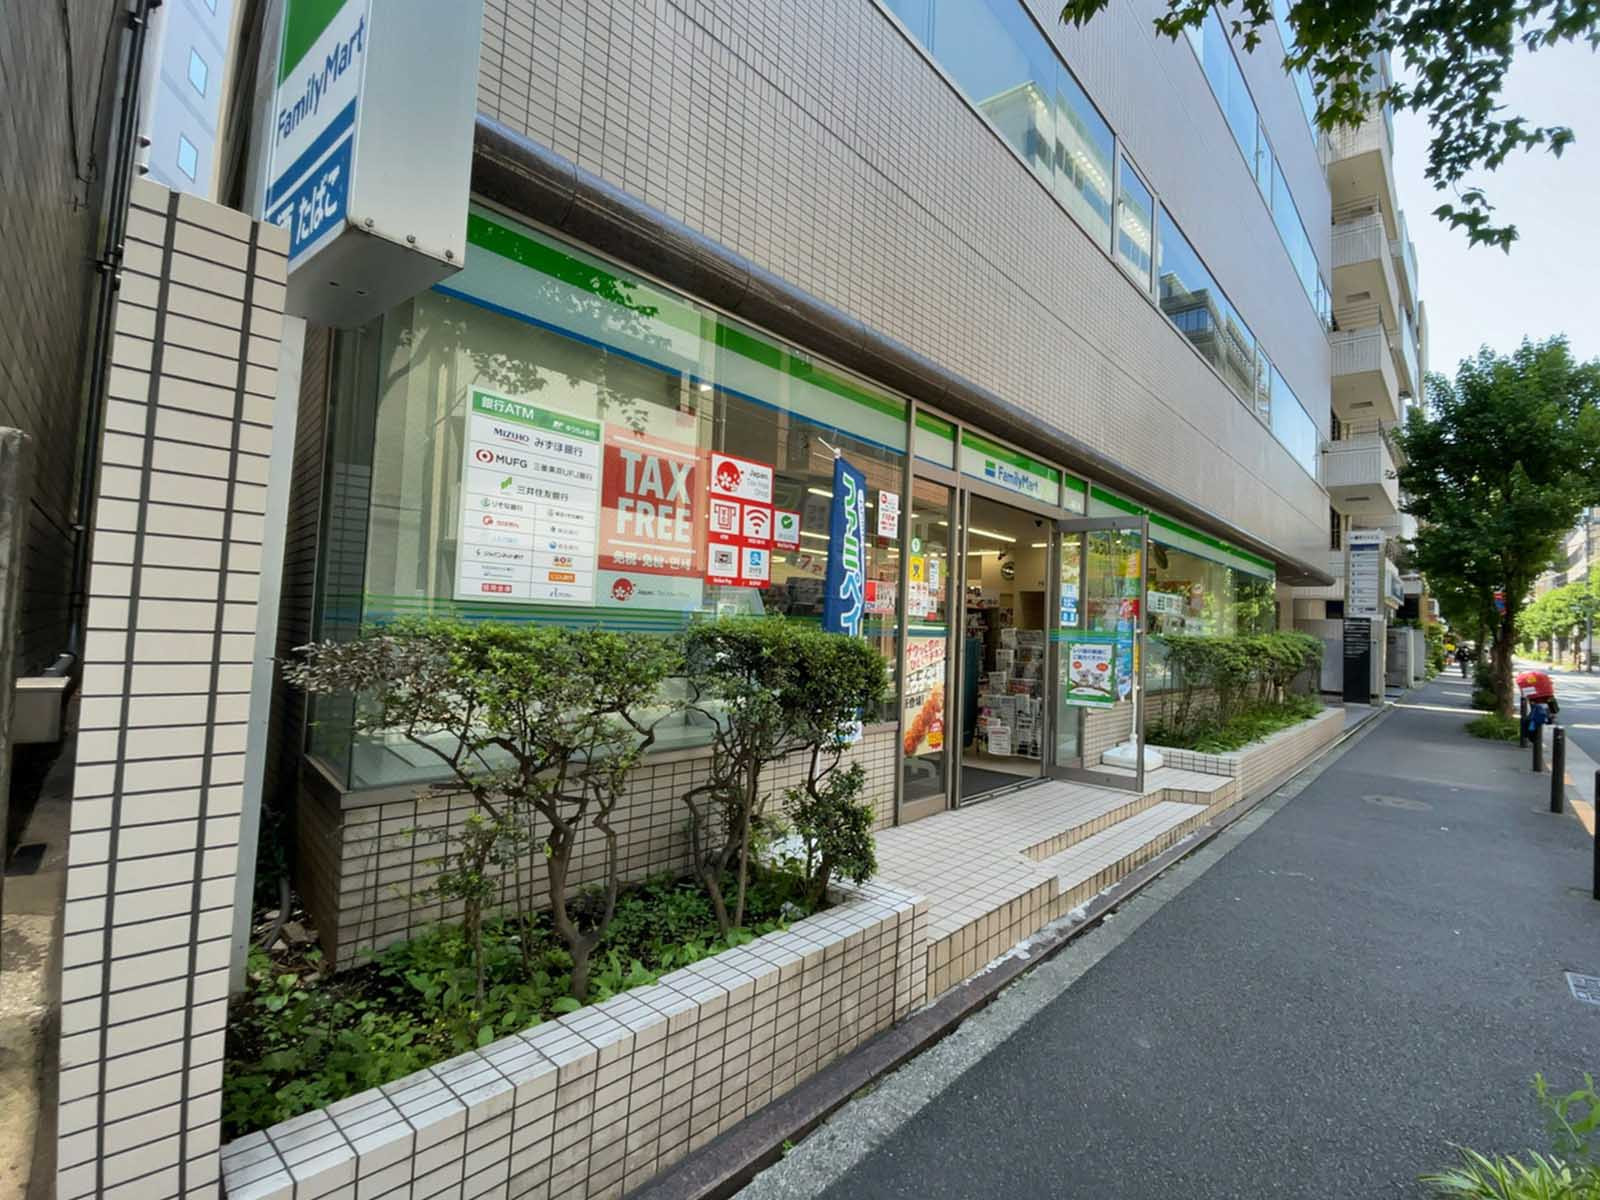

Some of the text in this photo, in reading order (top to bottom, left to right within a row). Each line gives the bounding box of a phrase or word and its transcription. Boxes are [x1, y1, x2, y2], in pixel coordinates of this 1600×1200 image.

[276, 16, 364, 147] FamilyMart
[296, 166, 340, 245] たばこ
[481, 396, 535, 420] 銀行ATM
[534, 437, 584, 457] みずほ銀行
[495, 454, 528, 469] MUFG
[619, 448, 695, 505] TAX
[998, 465, 1039, 491] FamilyMart
[517, 485, 569, 502] 三井住友銀行
[615, 496, 692, 544] FREE
